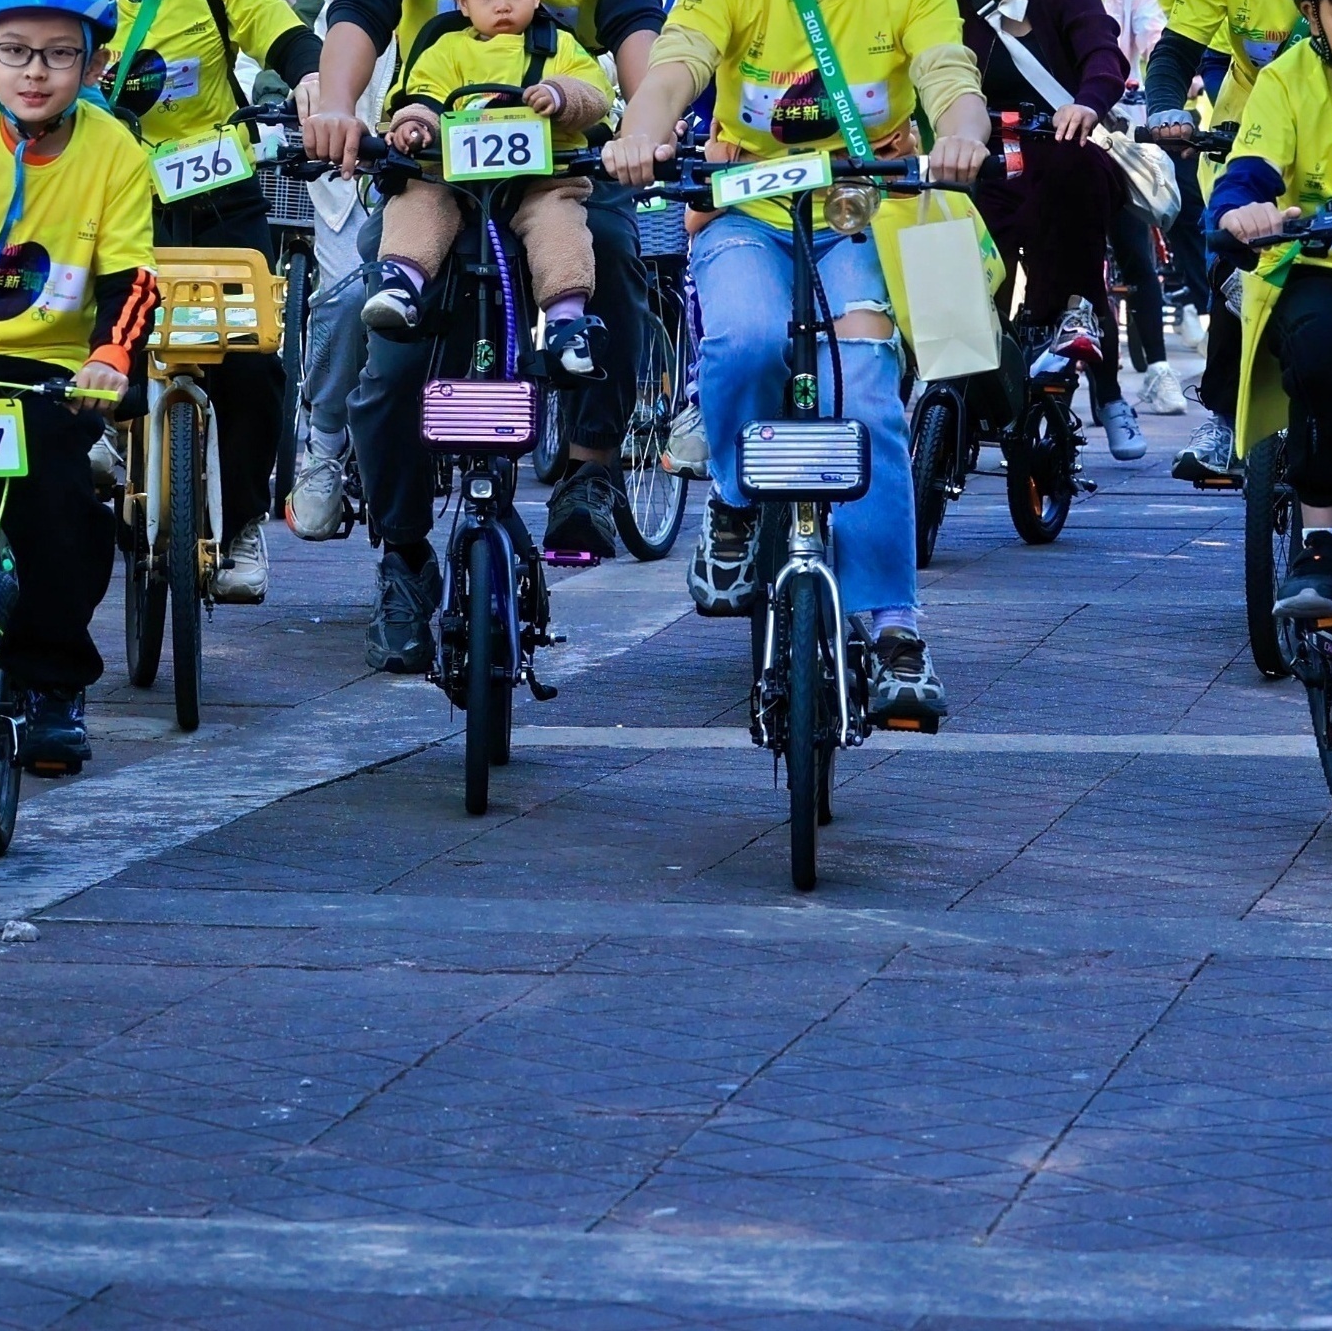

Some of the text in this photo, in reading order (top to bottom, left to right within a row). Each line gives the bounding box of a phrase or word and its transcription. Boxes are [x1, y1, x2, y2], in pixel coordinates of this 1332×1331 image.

[802, 9, 836, 77] CITY RIDE
[832, 90, 867, 156] CITY RIDE
[165, 150, 232, 191] 736
[462, 132, 532, 168] 128
[735, 166, 808, 196] 129
